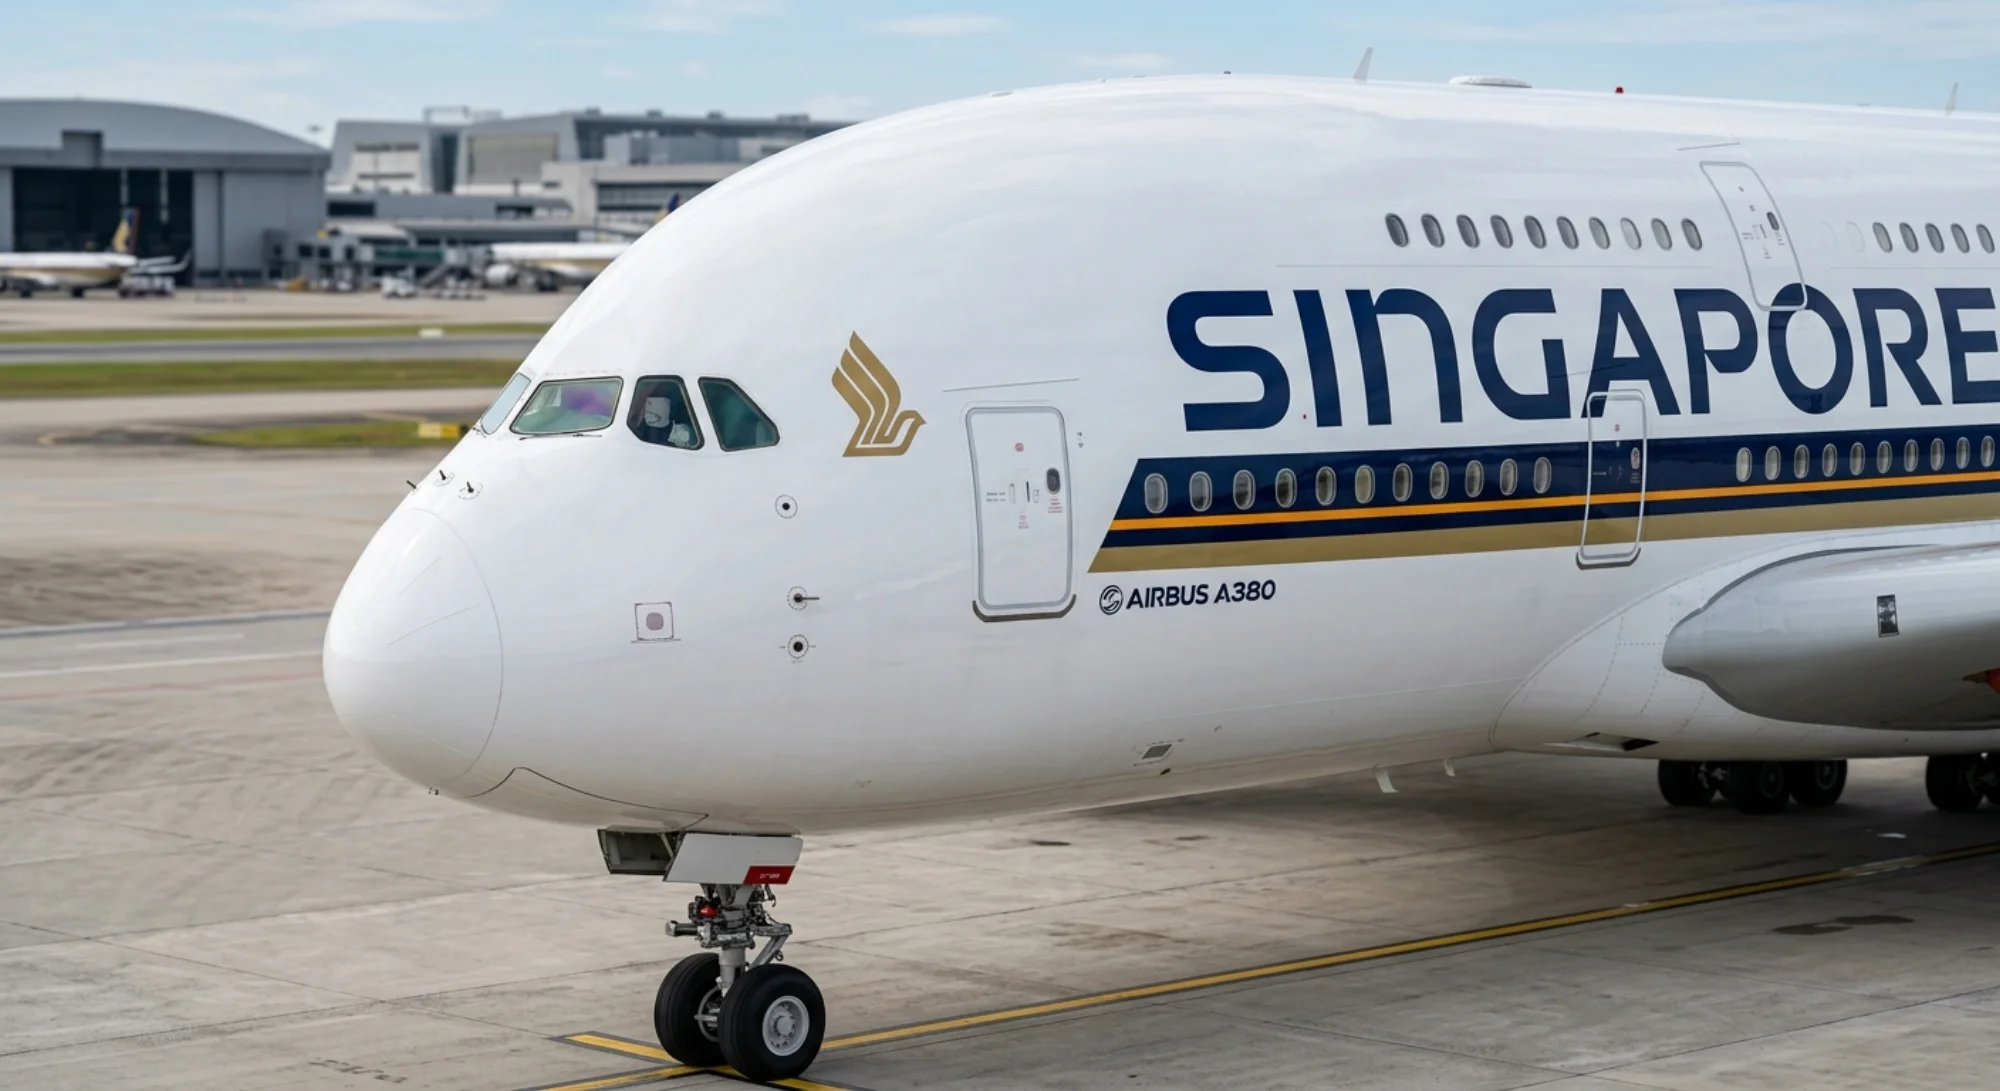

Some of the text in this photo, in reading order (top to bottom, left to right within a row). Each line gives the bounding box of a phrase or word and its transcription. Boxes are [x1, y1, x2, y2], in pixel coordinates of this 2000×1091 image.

[1166, 282, 2000, 432] SINGAPORE
[1125, 579, 1277, 610] AIRBUS A380
